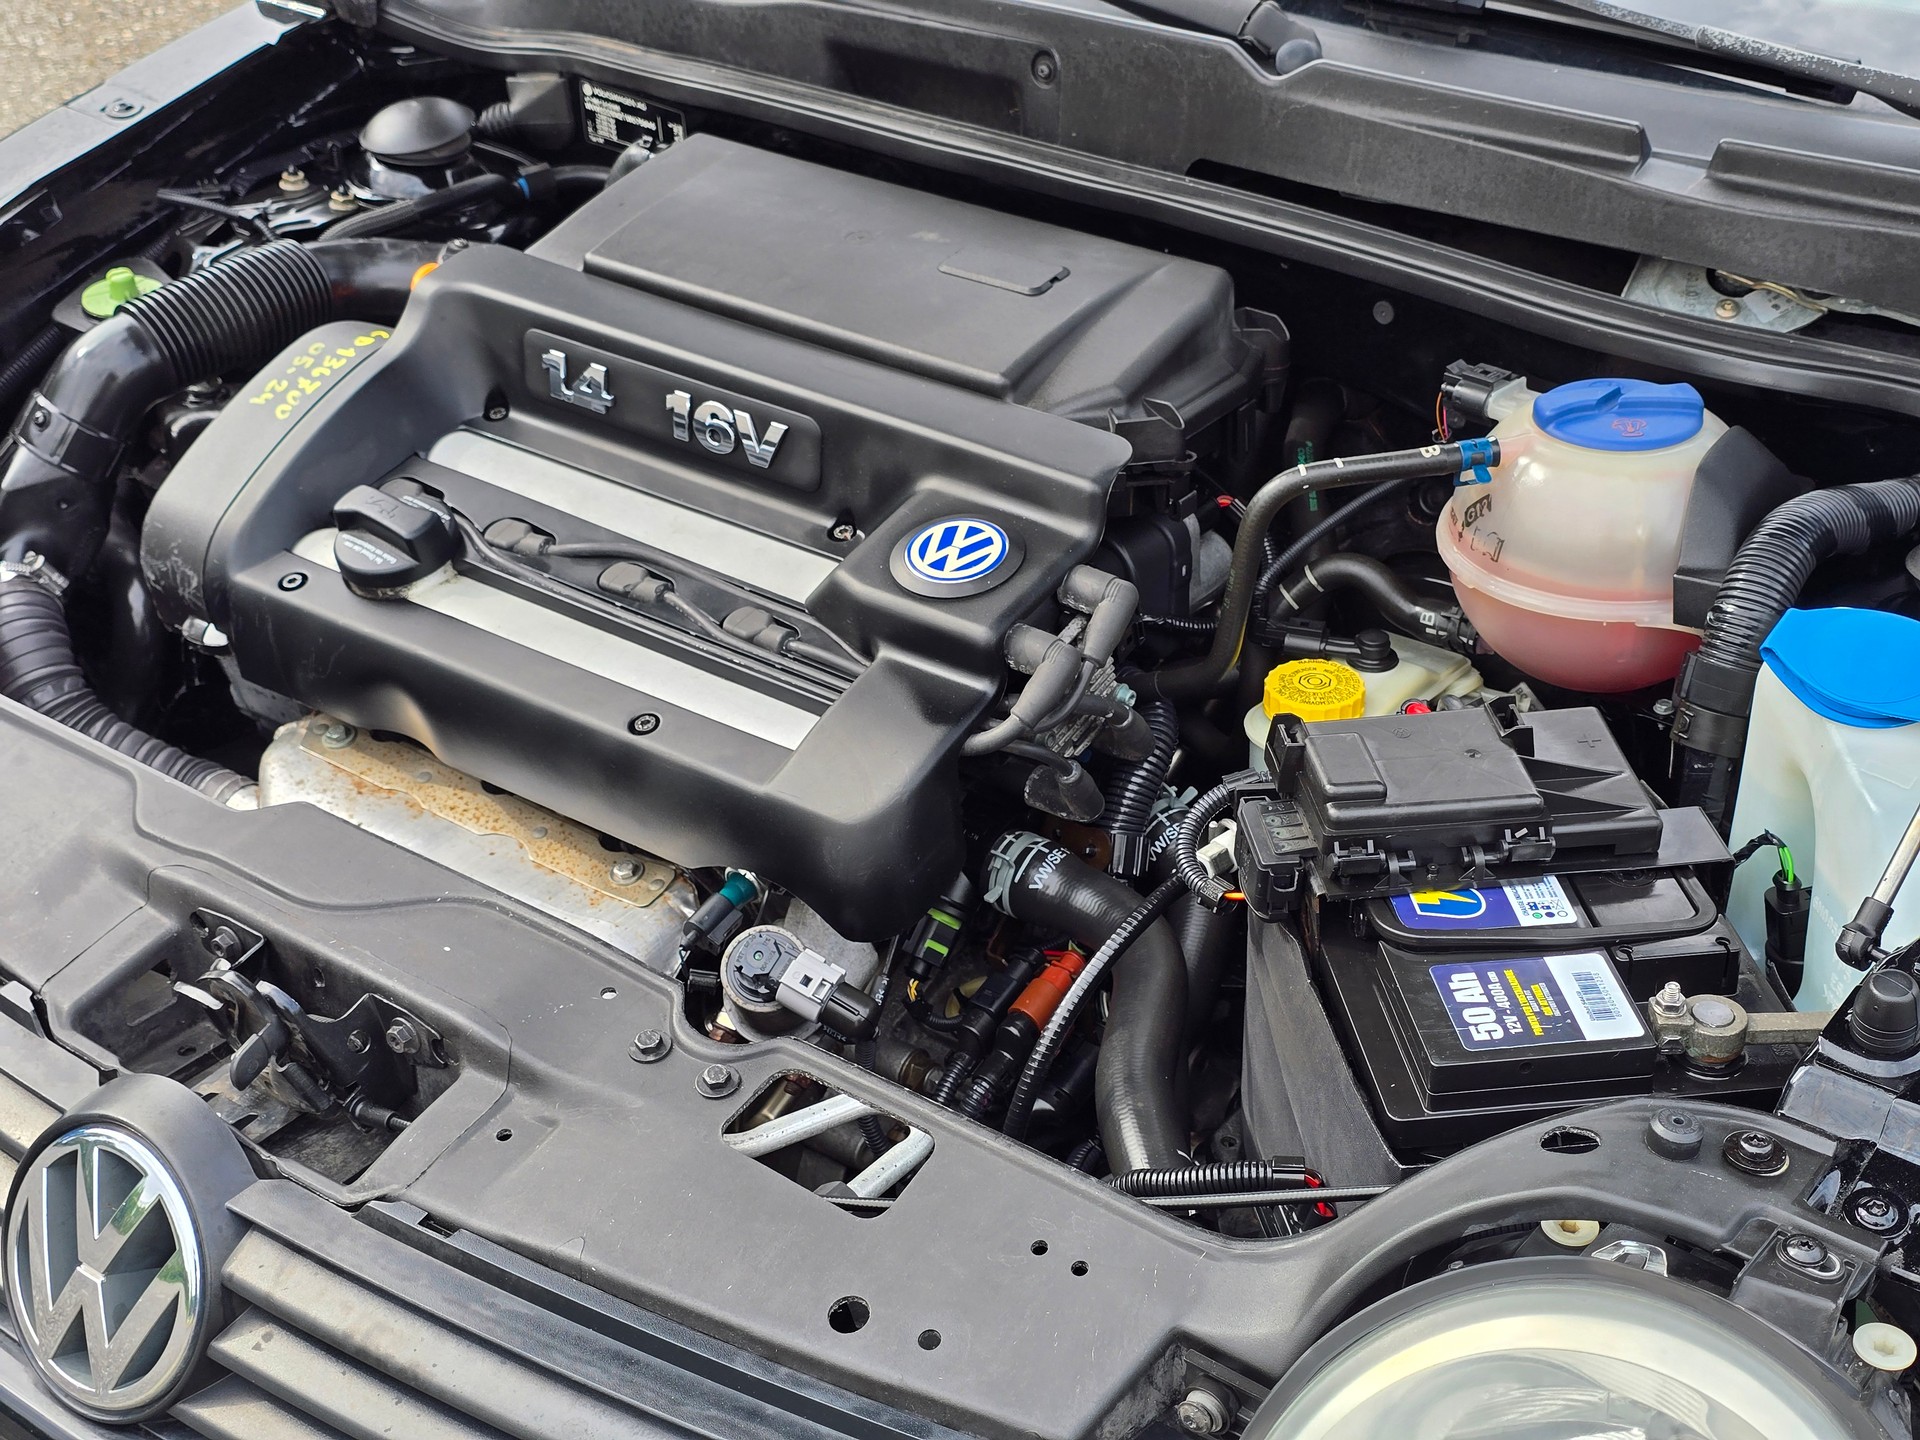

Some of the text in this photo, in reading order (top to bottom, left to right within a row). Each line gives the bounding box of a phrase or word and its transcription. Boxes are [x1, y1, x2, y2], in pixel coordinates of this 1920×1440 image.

[665, 389, 789, 469] 16V
[1419, 445, 1440, 458] B
[1419, 611, 1435, 626] B
[1448, 972, 1504, 1041] 50 Ah
[1487, 982, 1511, 1009] 400A
[1502, 1015, 1523, 1034] 12V
